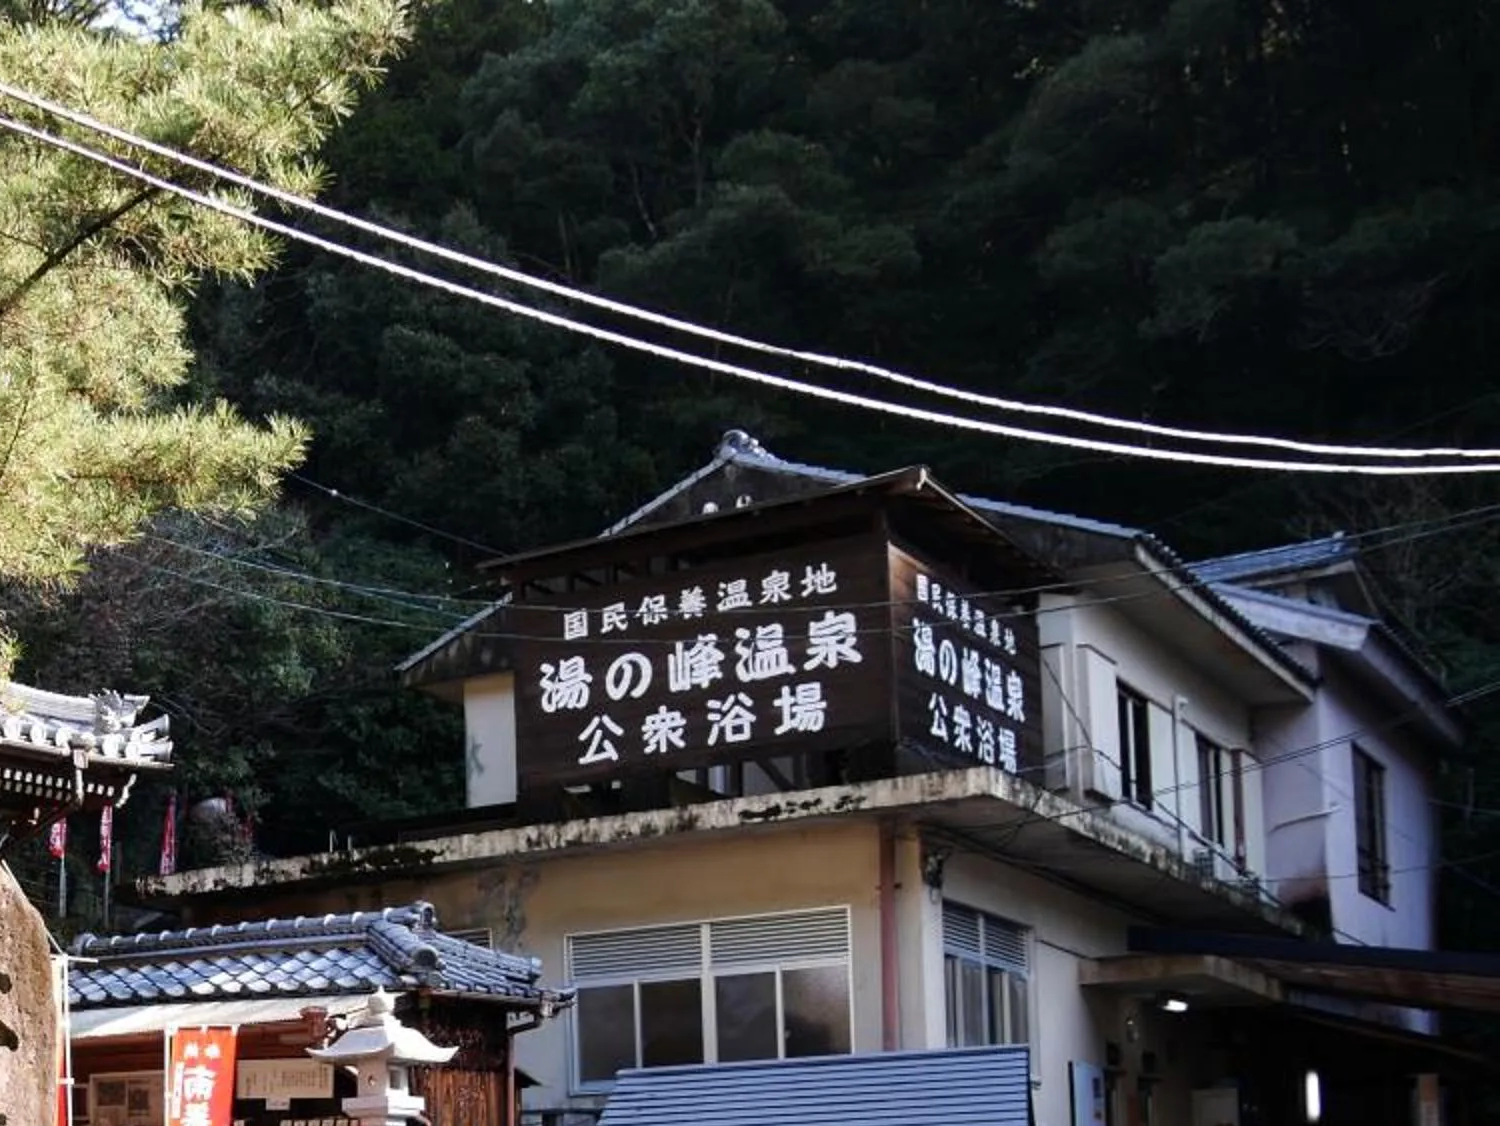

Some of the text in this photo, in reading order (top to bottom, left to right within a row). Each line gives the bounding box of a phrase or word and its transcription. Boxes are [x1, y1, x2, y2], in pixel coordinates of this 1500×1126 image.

[562, 562, 838, 641] 国民保養温泉地
[916, 573, 1017, 655] 国民保養温泉地
[538, 611, 863, 713] 湯の峰温泉
[912, 617, 1025, 723] 湯の峰温泉
[578, 682, 828, 766] 公衆浴場
[929, 692, 1018, 775] 公衆浴場
